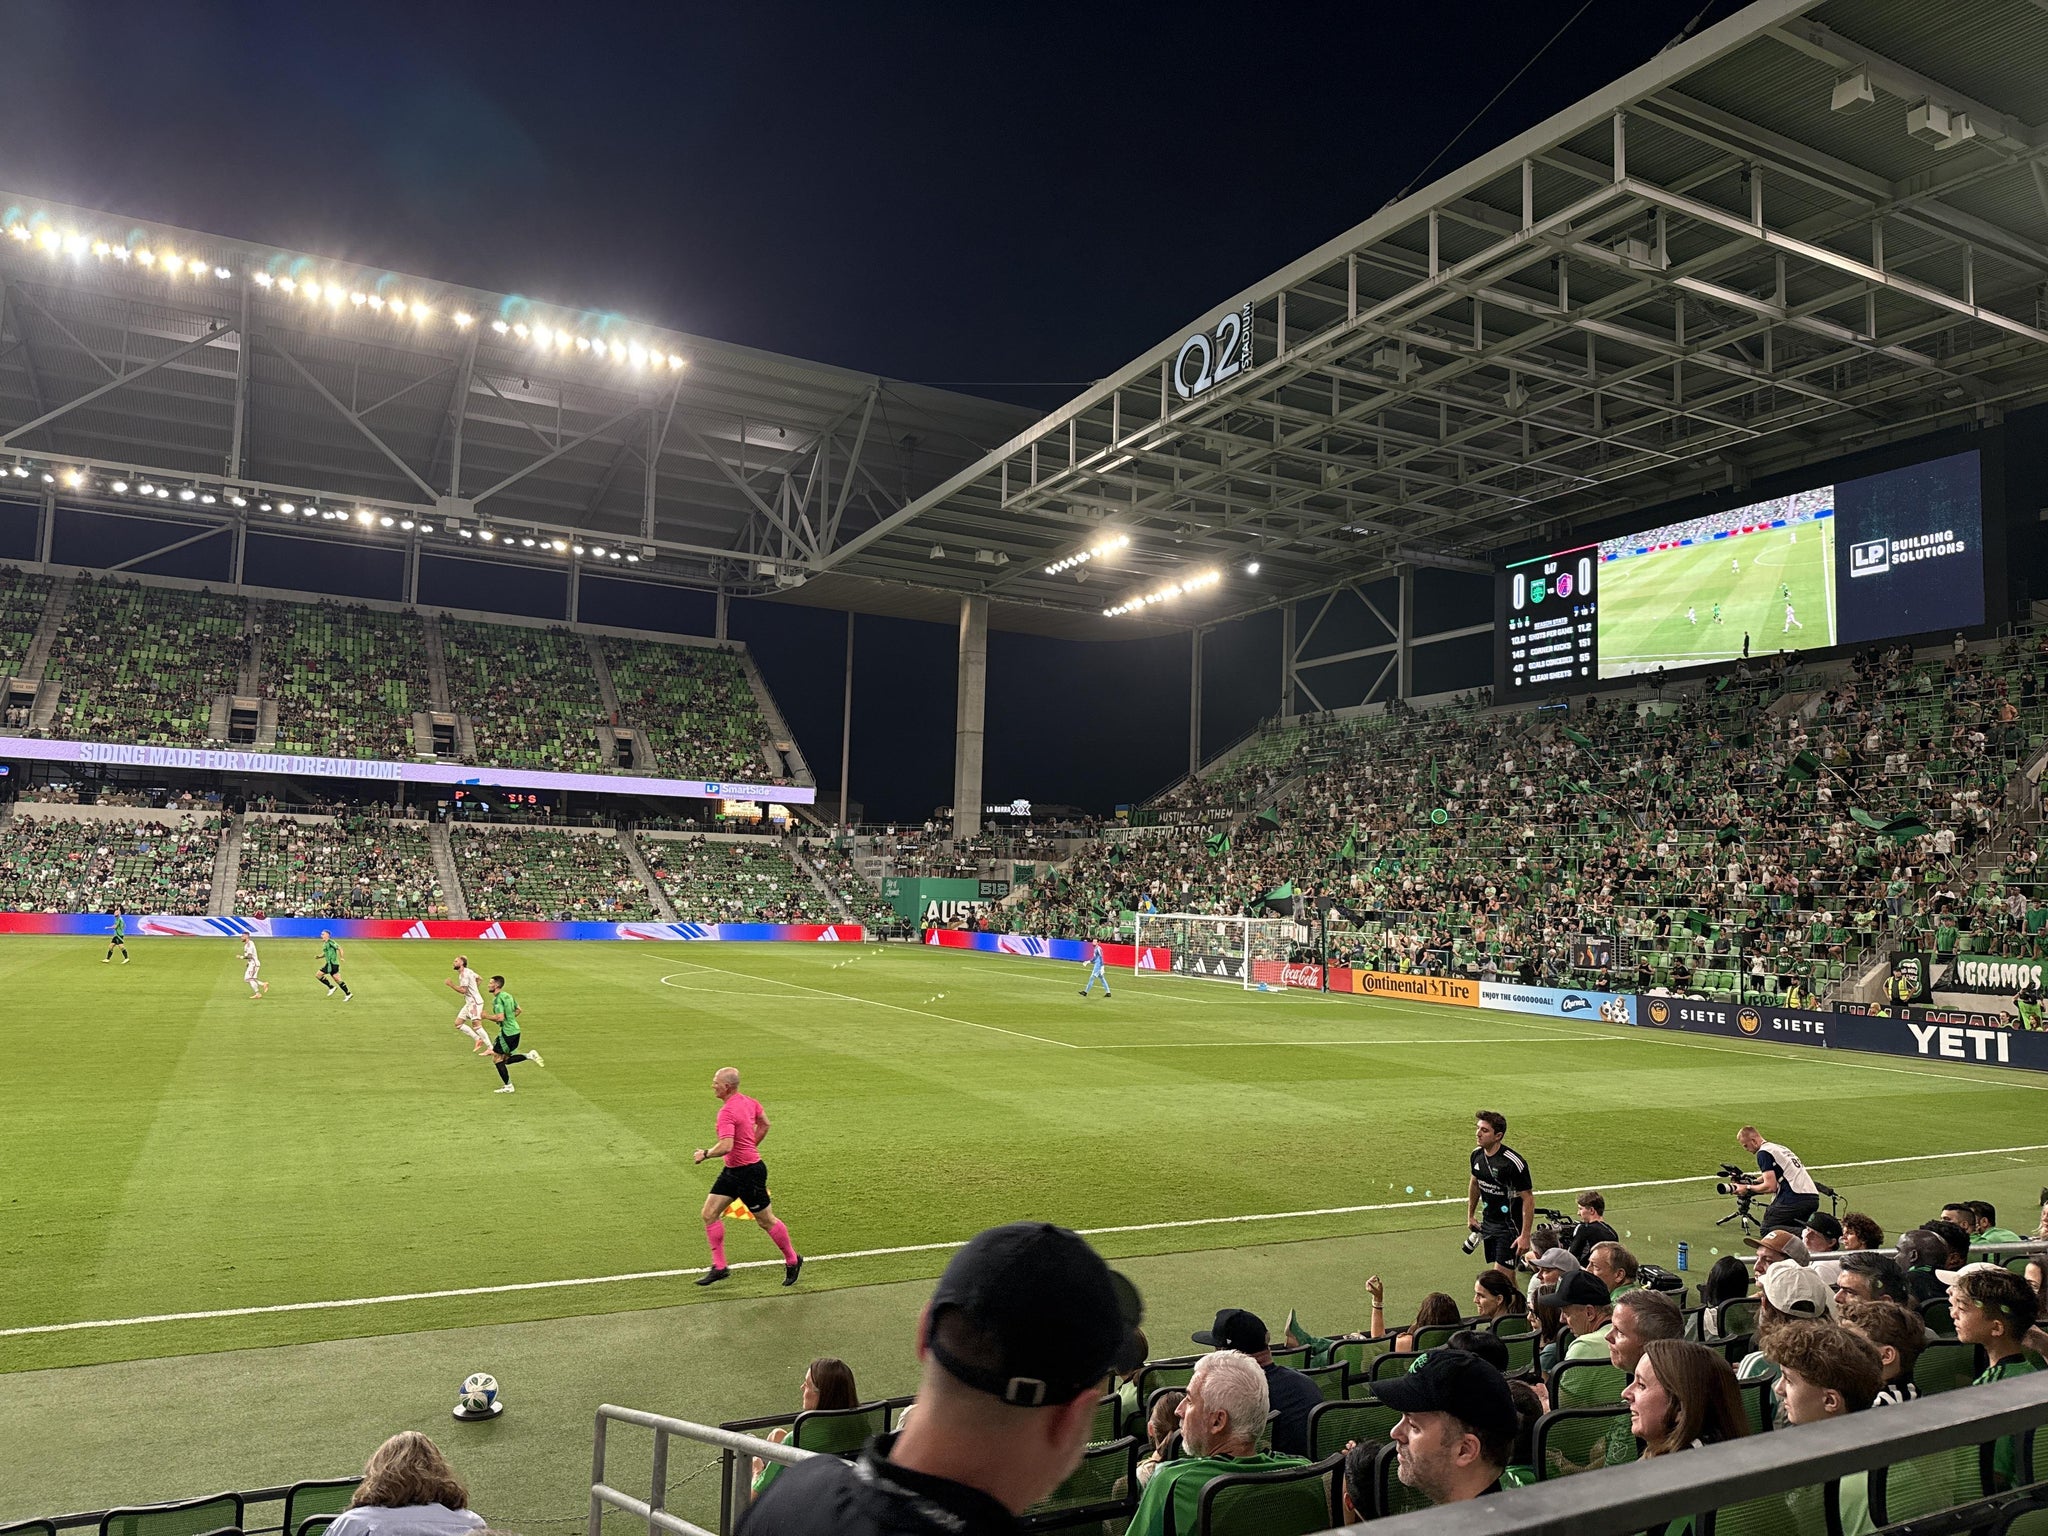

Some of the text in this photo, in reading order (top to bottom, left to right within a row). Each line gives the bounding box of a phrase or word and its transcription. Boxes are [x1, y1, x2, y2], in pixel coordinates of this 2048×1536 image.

[1174, 300, 1254, 399] Q2 STADIUM
[1891, 529, 1954, 552] BUILDING
[1891, 540, 1965, 565] SOLUTIONS
[1528, 632, 1546, 641] SHOTS
[1546, 630, 1557, 638] PER
[1557, 626, 1574, 636] GAME
[1530, 645, 1554, 656] CORNER
[1554, 642, 1572, 652] KICKS
[1530, 673, 1549, 683] CLEAN
[1549, 670, 1572, 680] SHEETS
[79, 742, 402, 779] SIDING MADE FOR YOUR DREAM HOME
[706, 784, 770, 796] LP SmartSide
[1282, 963, 1320, 987] Coca-Cola
[1362, 974, 1470, 998] Continental Tire
[1482, 991, 1500, 1000] ENJOY
[1680, 1009, 1726, 1024] SIETE
[1773, 1018, 1825, 1034] SIETE
[1907, 1023, 2010, 1063] YETI
